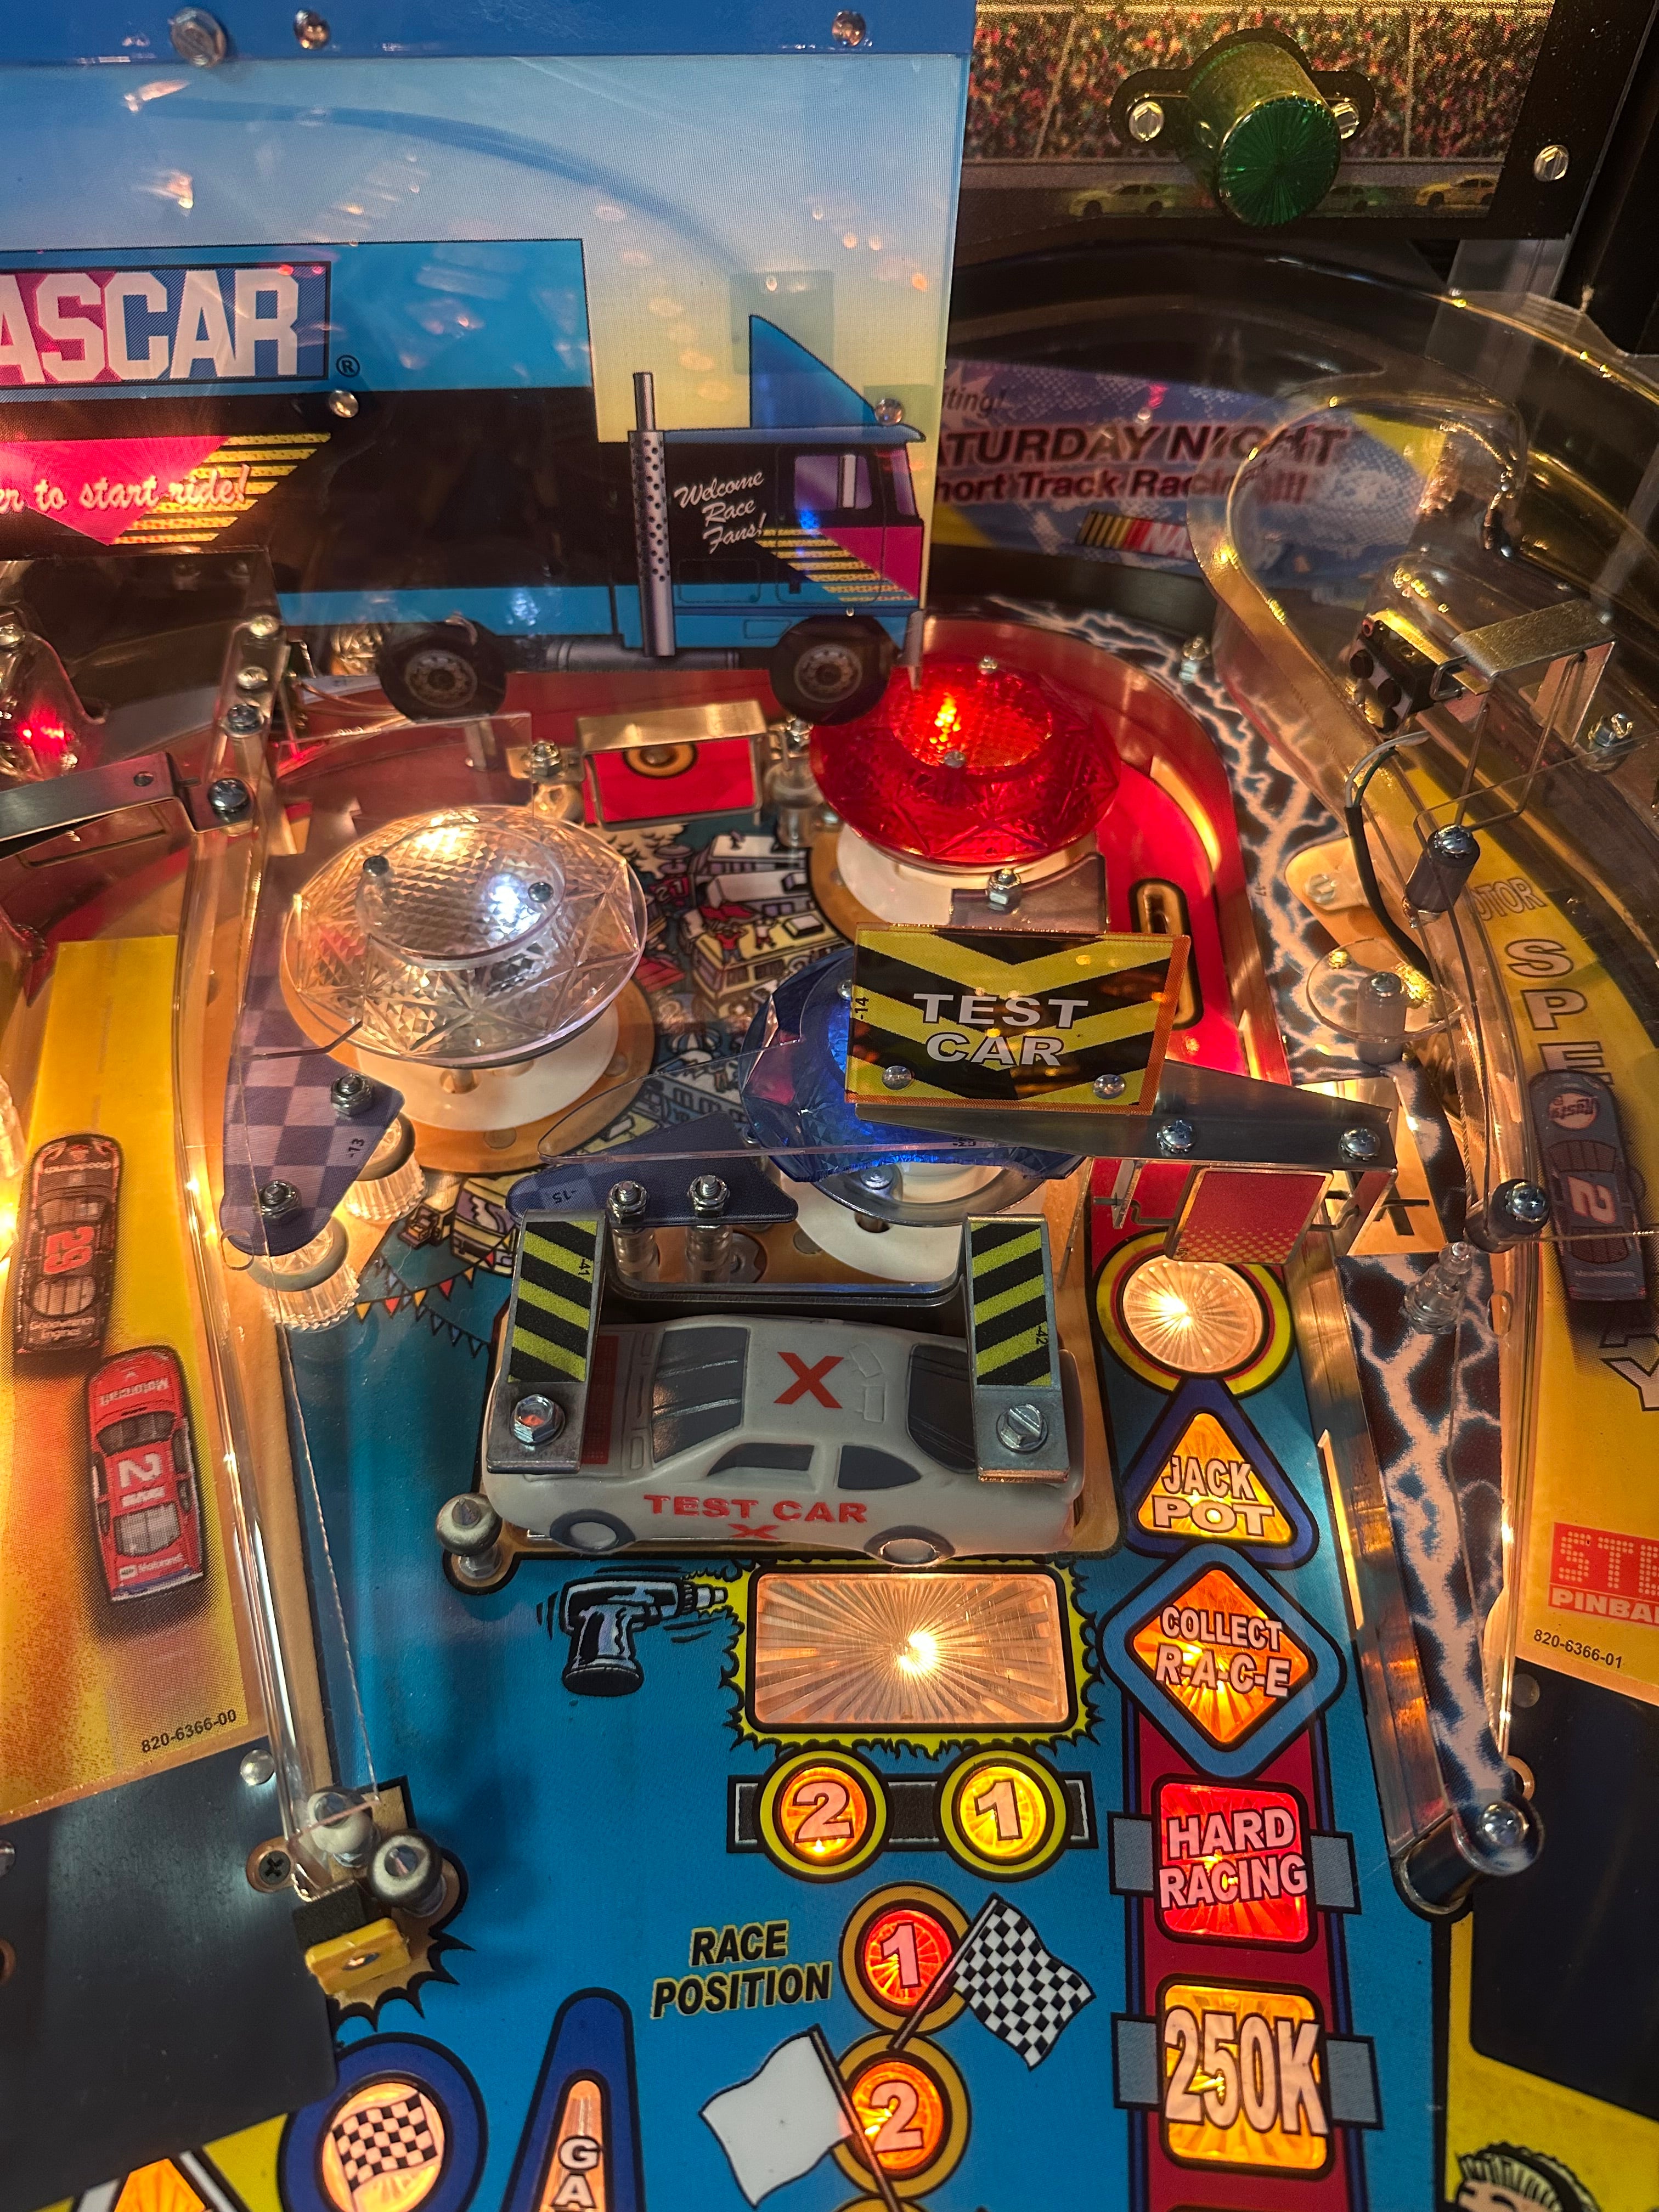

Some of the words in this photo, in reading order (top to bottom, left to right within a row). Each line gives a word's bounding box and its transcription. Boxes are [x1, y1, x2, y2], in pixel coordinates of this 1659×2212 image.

[937, 426, 1159, 466] TURDAY
[33, 478, 67, 513] to
[79, 475, 160, 511] start
[165, 463, 251, 507] ride!
[673, 472, 765, 509] Welcome
[1017, 469, 1119, 500] Track
[701, 499, 757, 528] Race
[702, 511, 768, 555] Fans!
[854, 996, 870, 1020] -14
[913, 993, 1089, 1030] TEST
[926, 1031, 1065, 1066] CAR
[348, 1138, 365, 1158] -13
[552, 1189, 577, 1204] -15
[1569, 1175, 1617, 1224] 2
[578, 1258, 591, 1276] -41
[1035, 1325, 1049, 1345] -42
[1160, 1455, 1257, 1502] JACK
[644, 1494, 759, 1519] TEST
[772, 1500, 868, 1523] CAR
[1152, 1494, 1276, 1537] POT
[1159, 1605, 1283, 1652] COLLECT
[1533, 1628, 1623, 1669] 820-6366-01
[1155, 1643, 1291, 1698] R-A-C-E
[141, 1709, 237, 1754] 820-6366-00
[792, 1780, 855, 1843] 2
[973, 1778, 1023, 1841] 1
[1166, 1807, 1296, 1860] HARD
[1158, 1853, 1308, 1910] RACING
[690, 1920, 789, 1967] RACE
[881, 1921, 920, 1989] 1
[651, 1961, 833, 2019] POSITION
[1163, 2007, 1330, 2136] 250K
[868, 2079, 926, 2153] 2
